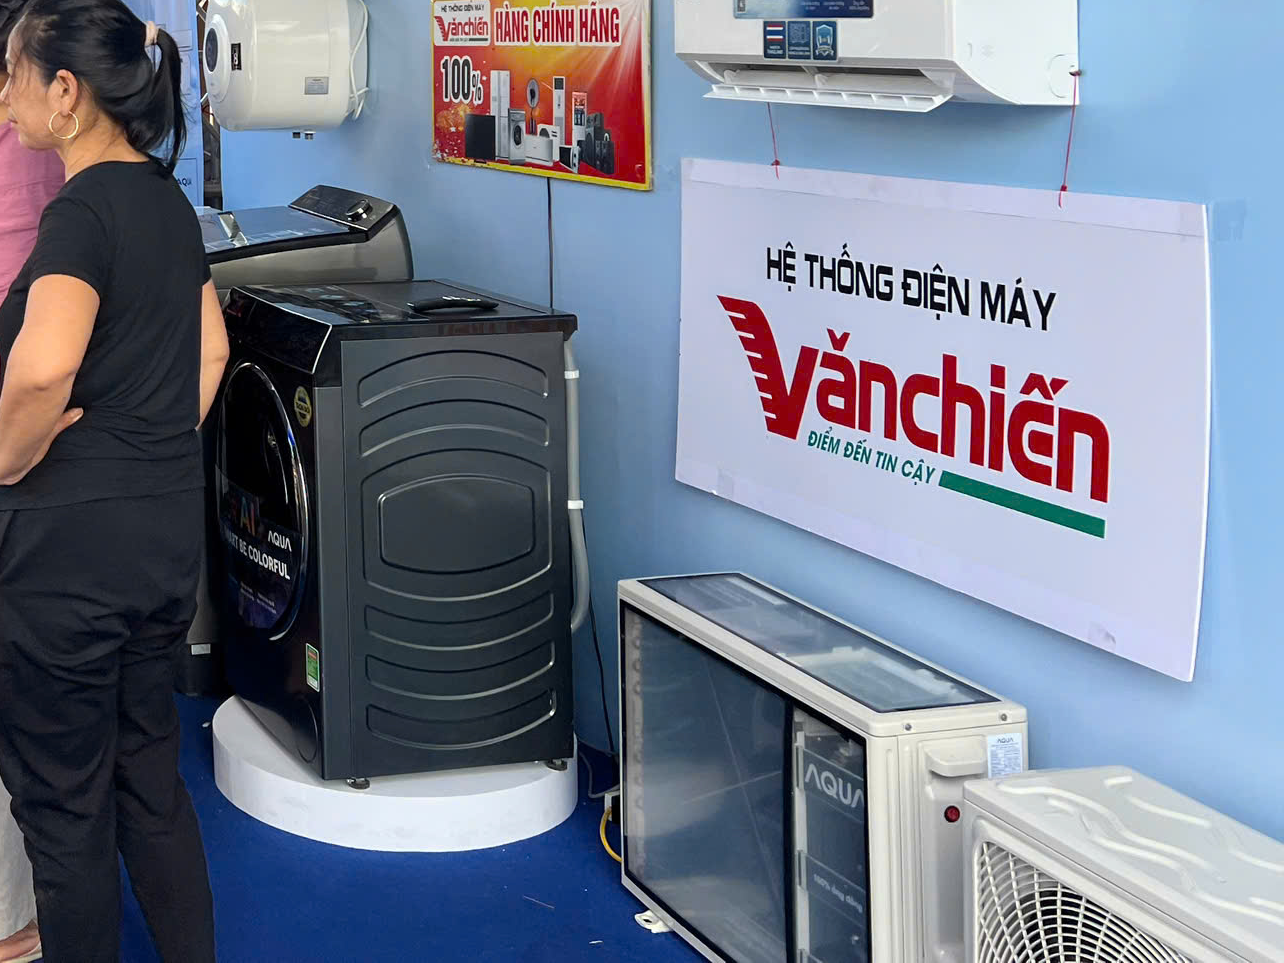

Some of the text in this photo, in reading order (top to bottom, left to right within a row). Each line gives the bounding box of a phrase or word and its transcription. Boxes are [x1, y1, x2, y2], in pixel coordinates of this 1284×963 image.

[495, 0, 620, 43] HÀNG CHÍNH HÃNG
[441, 56, 484, 105] 100%
[766, 241, 1056, 331] HỆ THỐNG ĐIỆN MÁY
[717, 295, 1110, 503] Vănchiến
[807, 426, 936, 486] ĐIỂM ĐẾN TIN CẬY
[248, 544, 291, 580] COLORFUL
[268, 530, 292, 552] AQUA
[805, 763, 865, 808] AQUA
